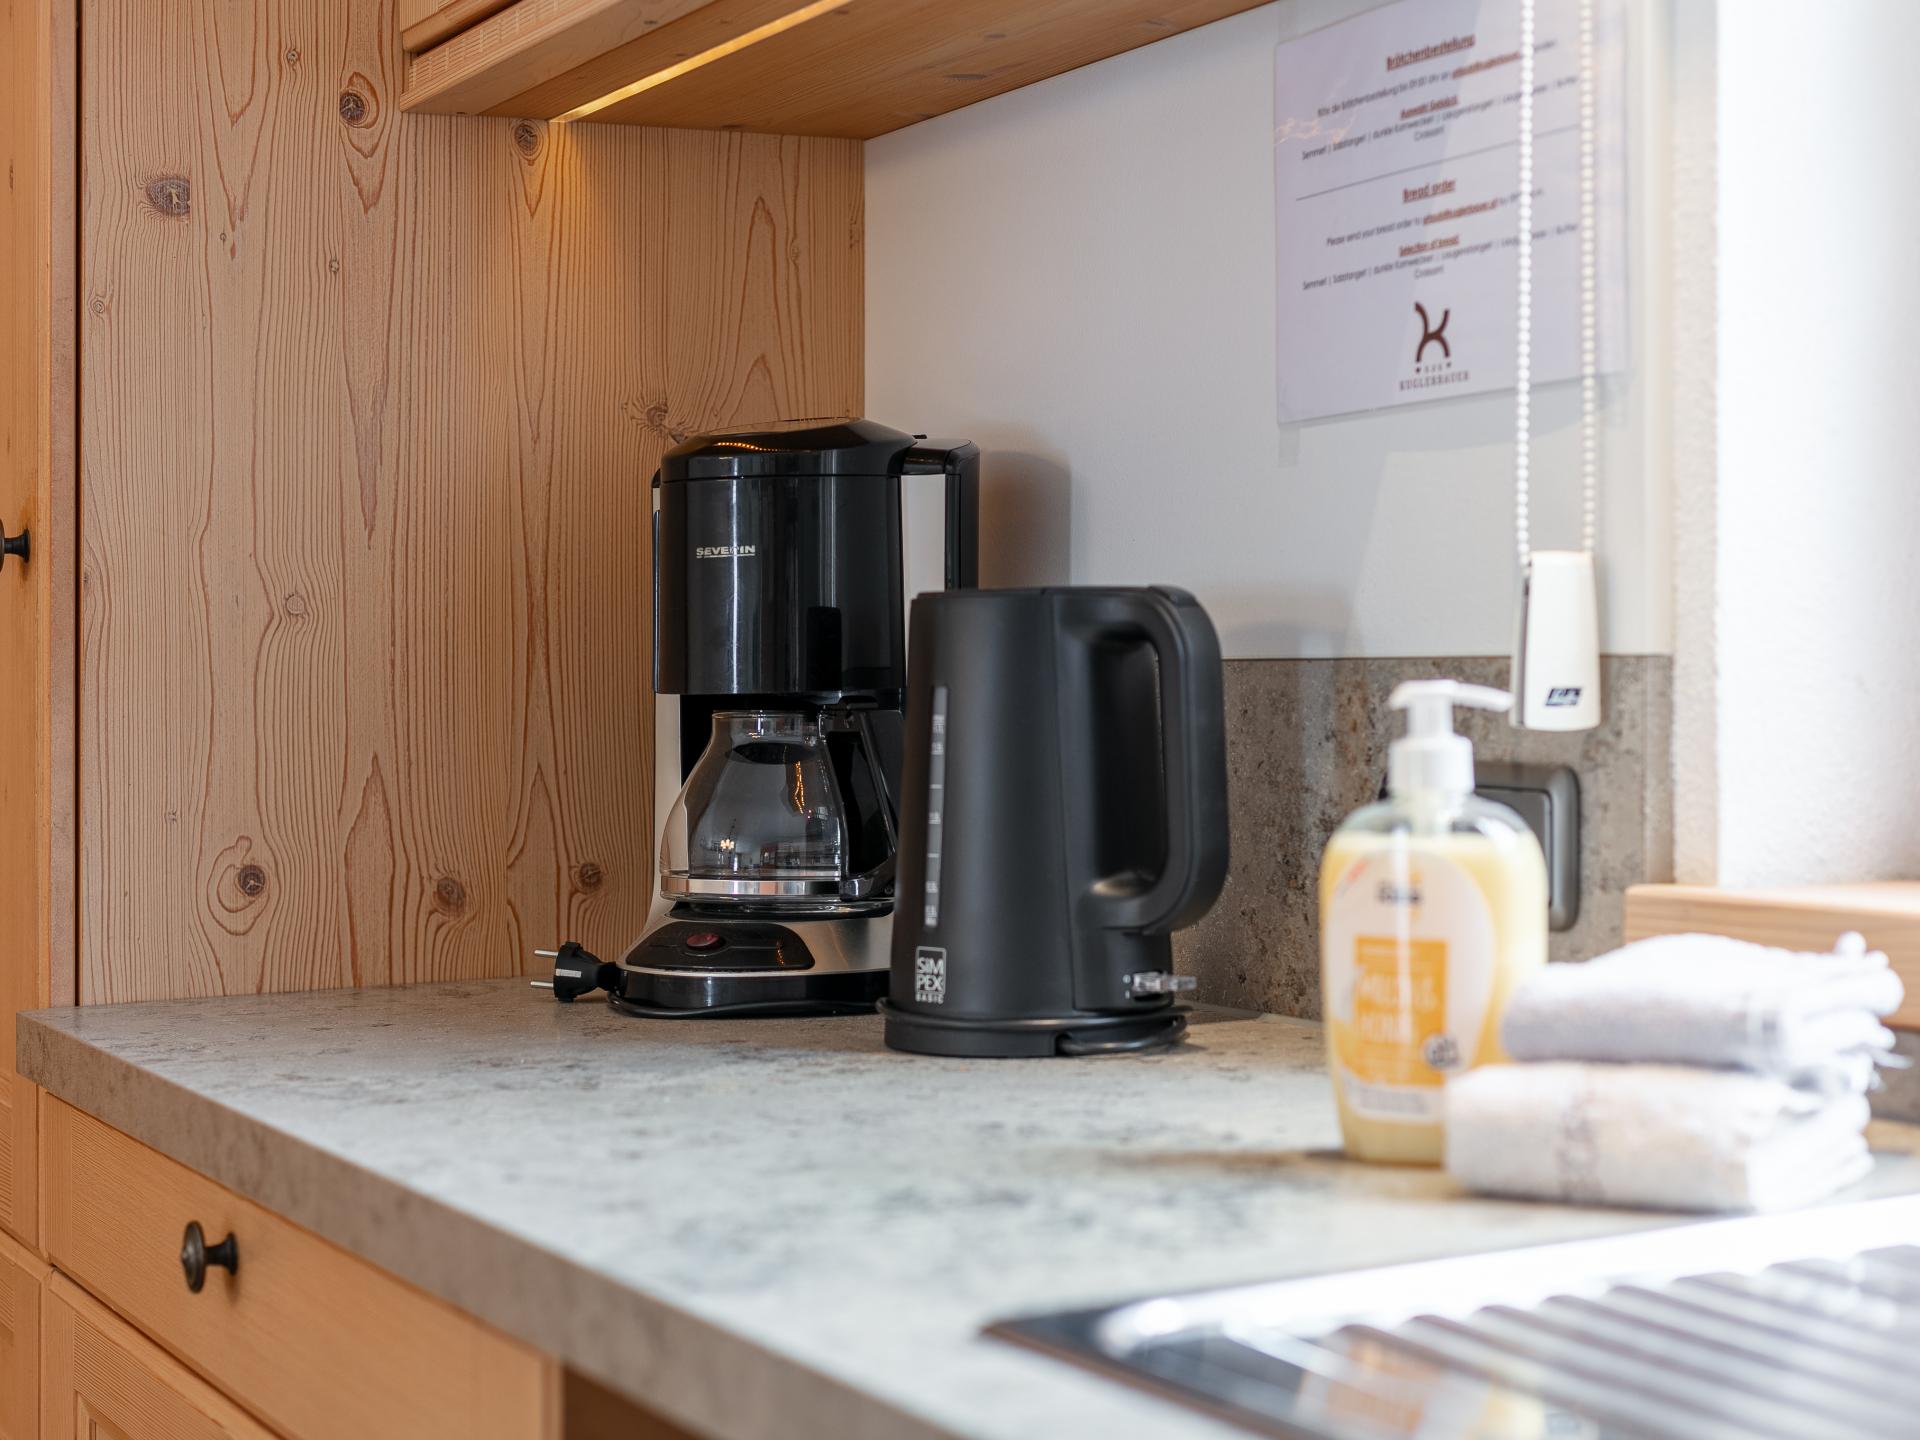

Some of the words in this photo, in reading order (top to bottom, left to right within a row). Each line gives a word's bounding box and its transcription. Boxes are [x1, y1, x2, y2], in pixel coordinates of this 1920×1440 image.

[1402, 182, 1430, 204] Bread
[1431, 178, 1457, 196] order
[916, 974, 944, 992] PEX
